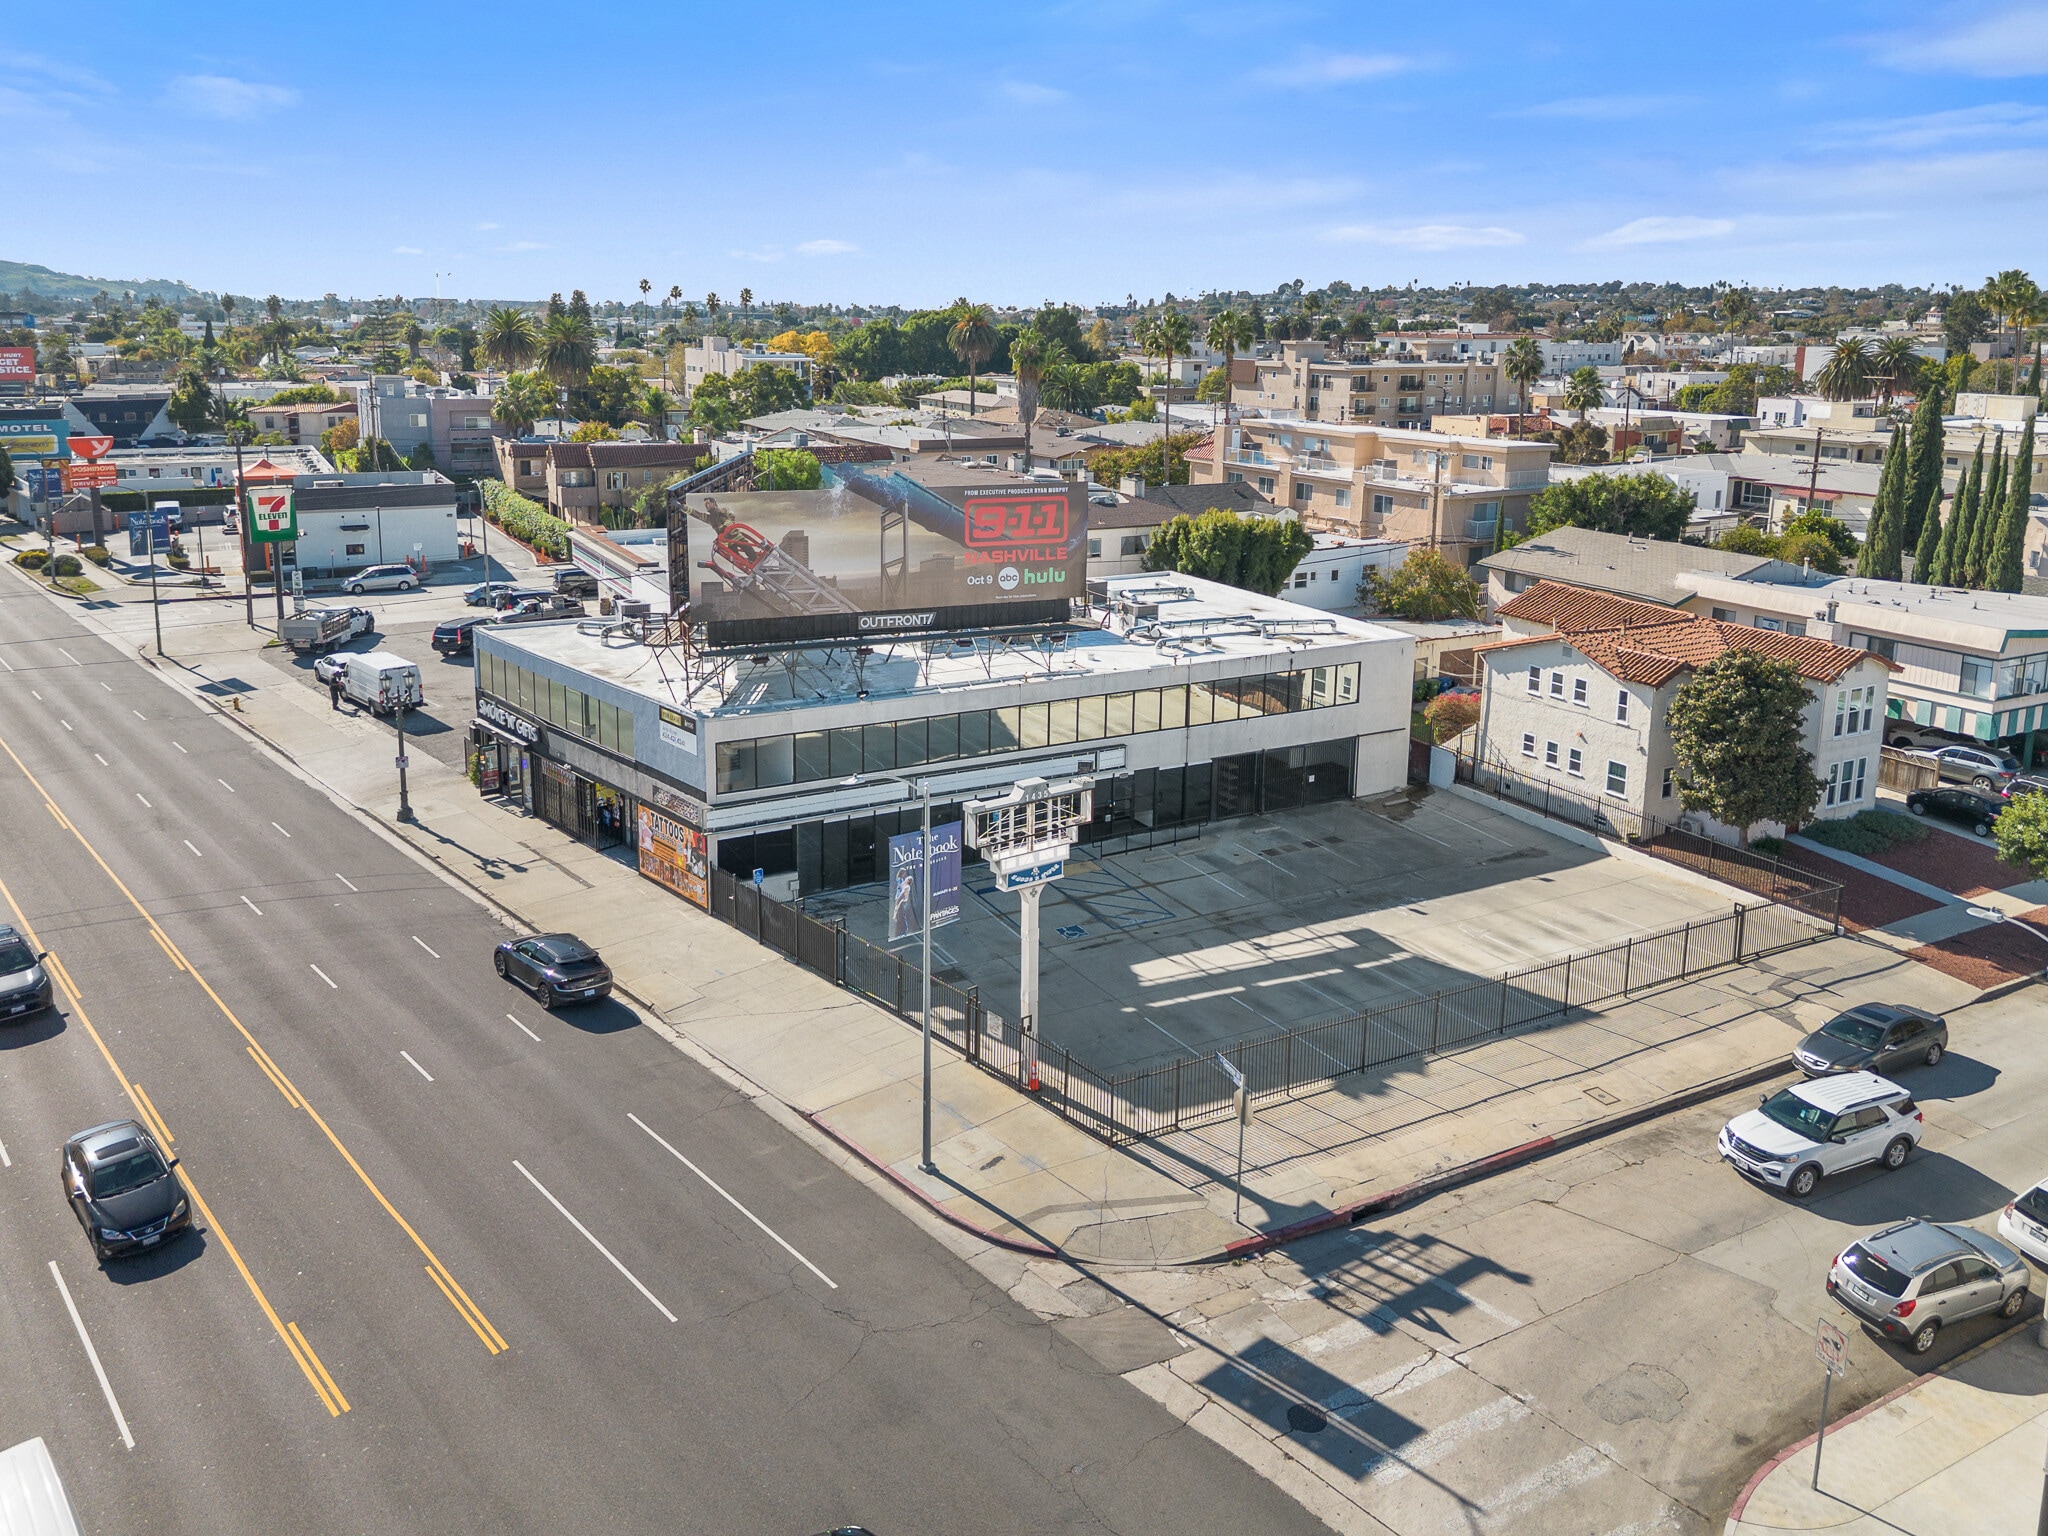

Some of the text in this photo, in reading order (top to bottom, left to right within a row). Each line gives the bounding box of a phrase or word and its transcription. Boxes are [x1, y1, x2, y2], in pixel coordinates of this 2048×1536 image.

[964, 547, 1068, 565] NASHVILLE
[967, 567, 1065, 585] Oct 9 abc hulu
[1025, 789, 1048, 801] 1435
[650, 811, 685, 843] TATTOOS
[893, 835, 958, 865] Notebook
